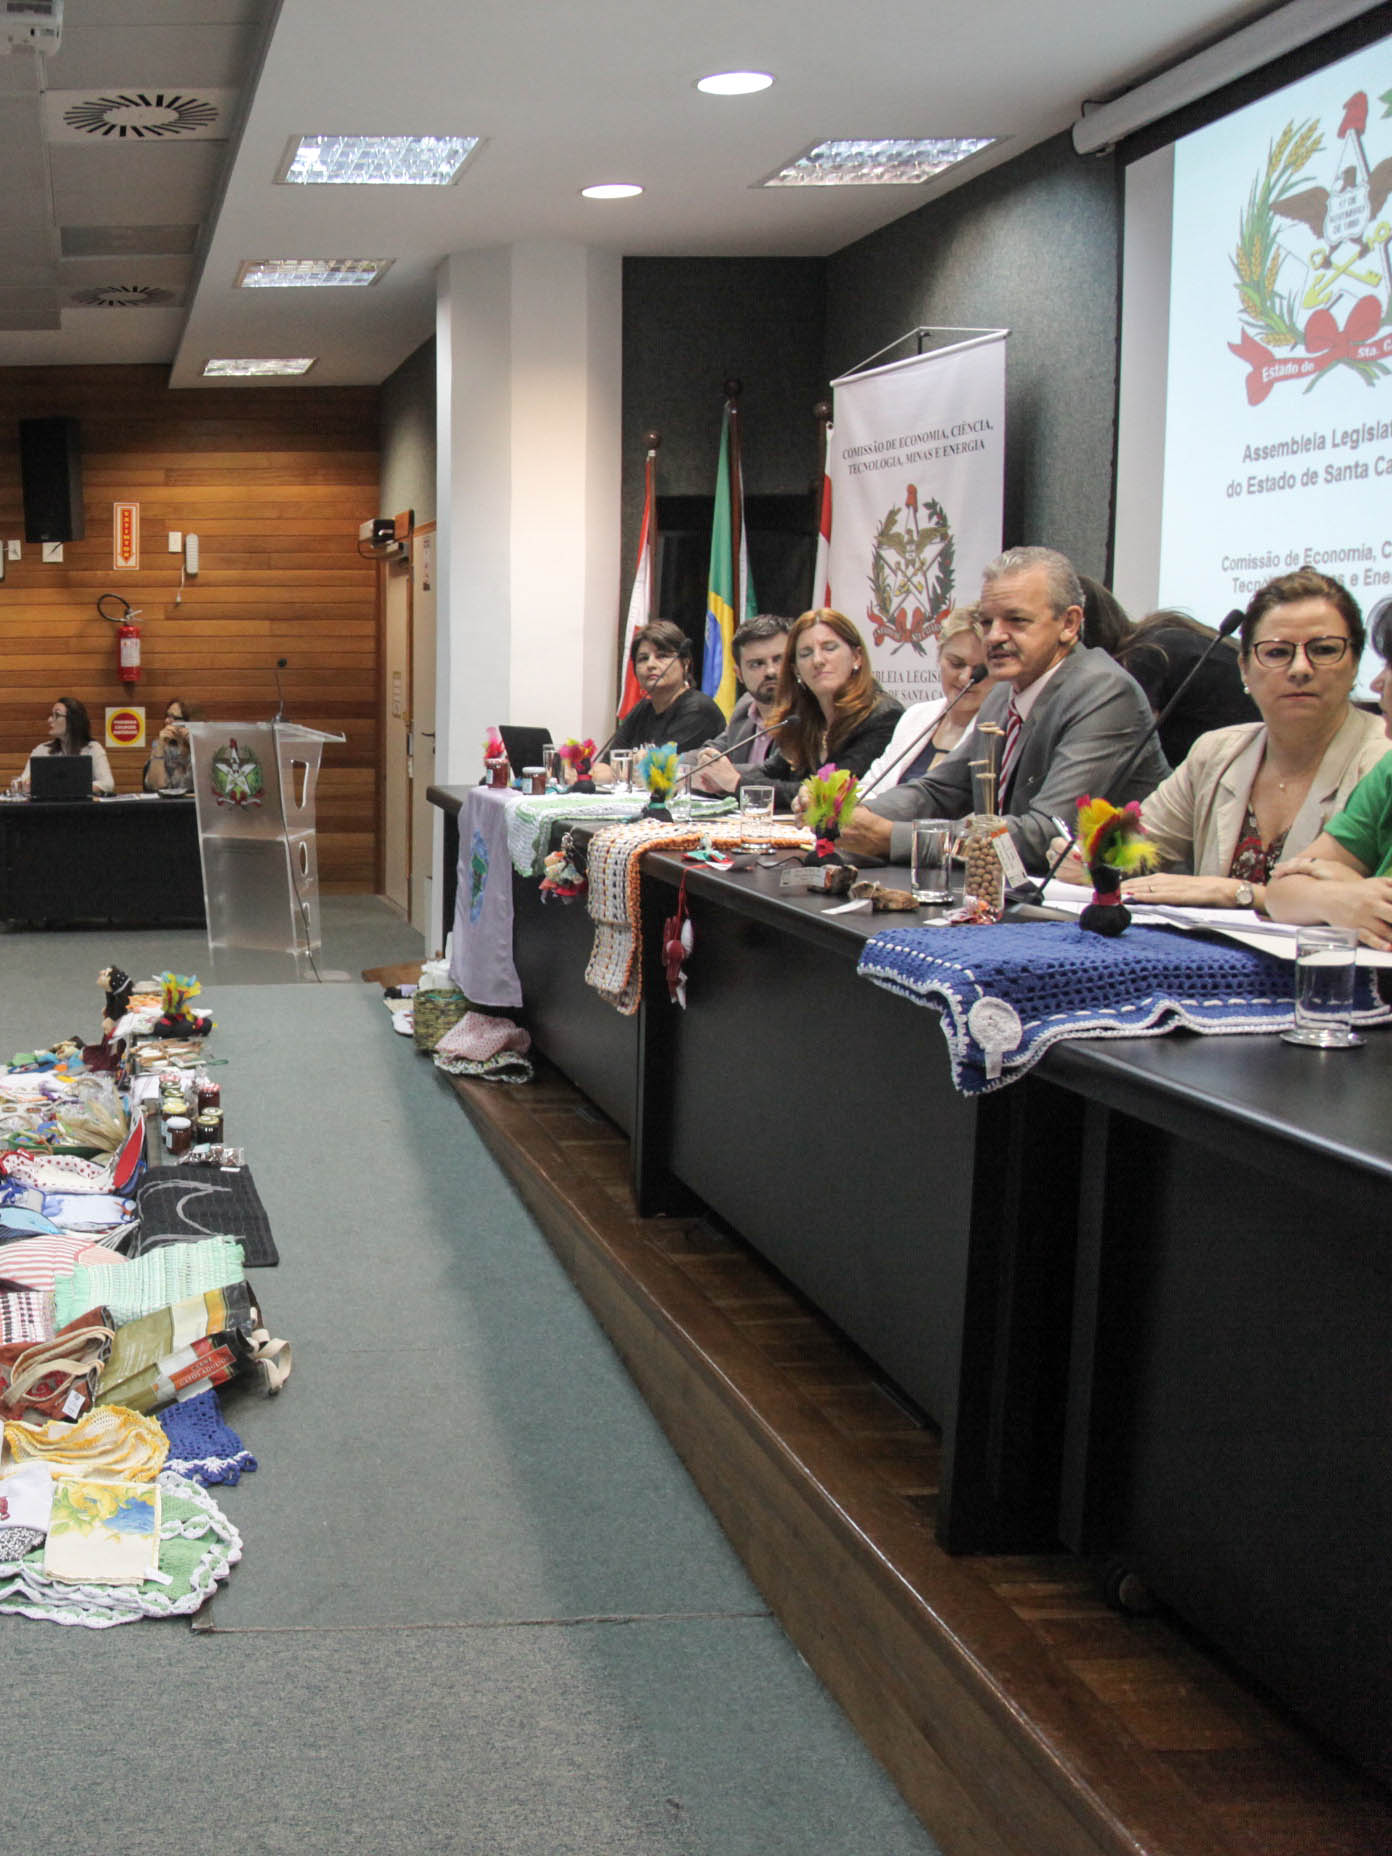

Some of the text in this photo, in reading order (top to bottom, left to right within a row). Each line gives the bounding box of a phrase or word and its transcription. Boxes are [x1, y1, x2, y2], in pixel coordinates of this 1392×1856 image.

[1262, 363, 1298, 382] Estado
[1301, 361, 1315, 373] de
[943, 438, 986, 457] ENERGIA
[1242, 432, 1326, 463] Assembleia
[1226, 479, 1243, 499] do
[1246, 471, 1296, 495] Estado
[1300, 467, 1319, 487] de
[1324, 461, 1369, 484] Santa
[1221, 551, 1280, 572] Comissão
[1284, 550, 1300, 567] de
[1304, 543, 1376, 565] Economia,
[1350, 573, 1359, 587] e
